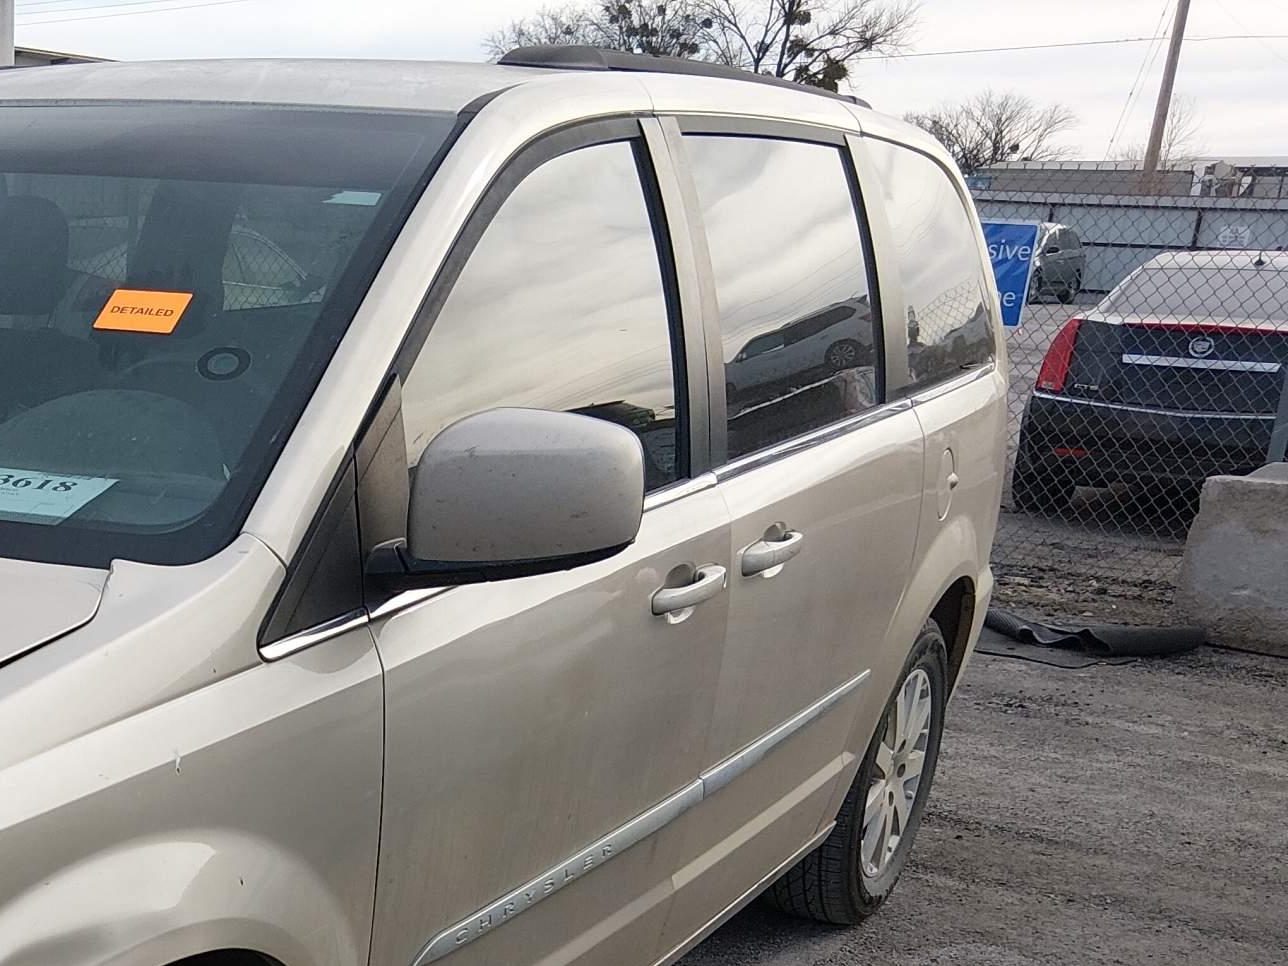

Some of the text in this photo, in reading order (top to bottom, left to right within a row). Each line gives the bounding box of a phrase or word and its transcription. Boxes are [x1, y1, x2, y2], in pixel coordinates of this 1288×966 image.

[988, 239, 1031, 261] sive
[998, 291, 1016, 307] e
[110, 305, 174, 318] DETAILED
[455, 844, 612, 945] CHRYSLER
